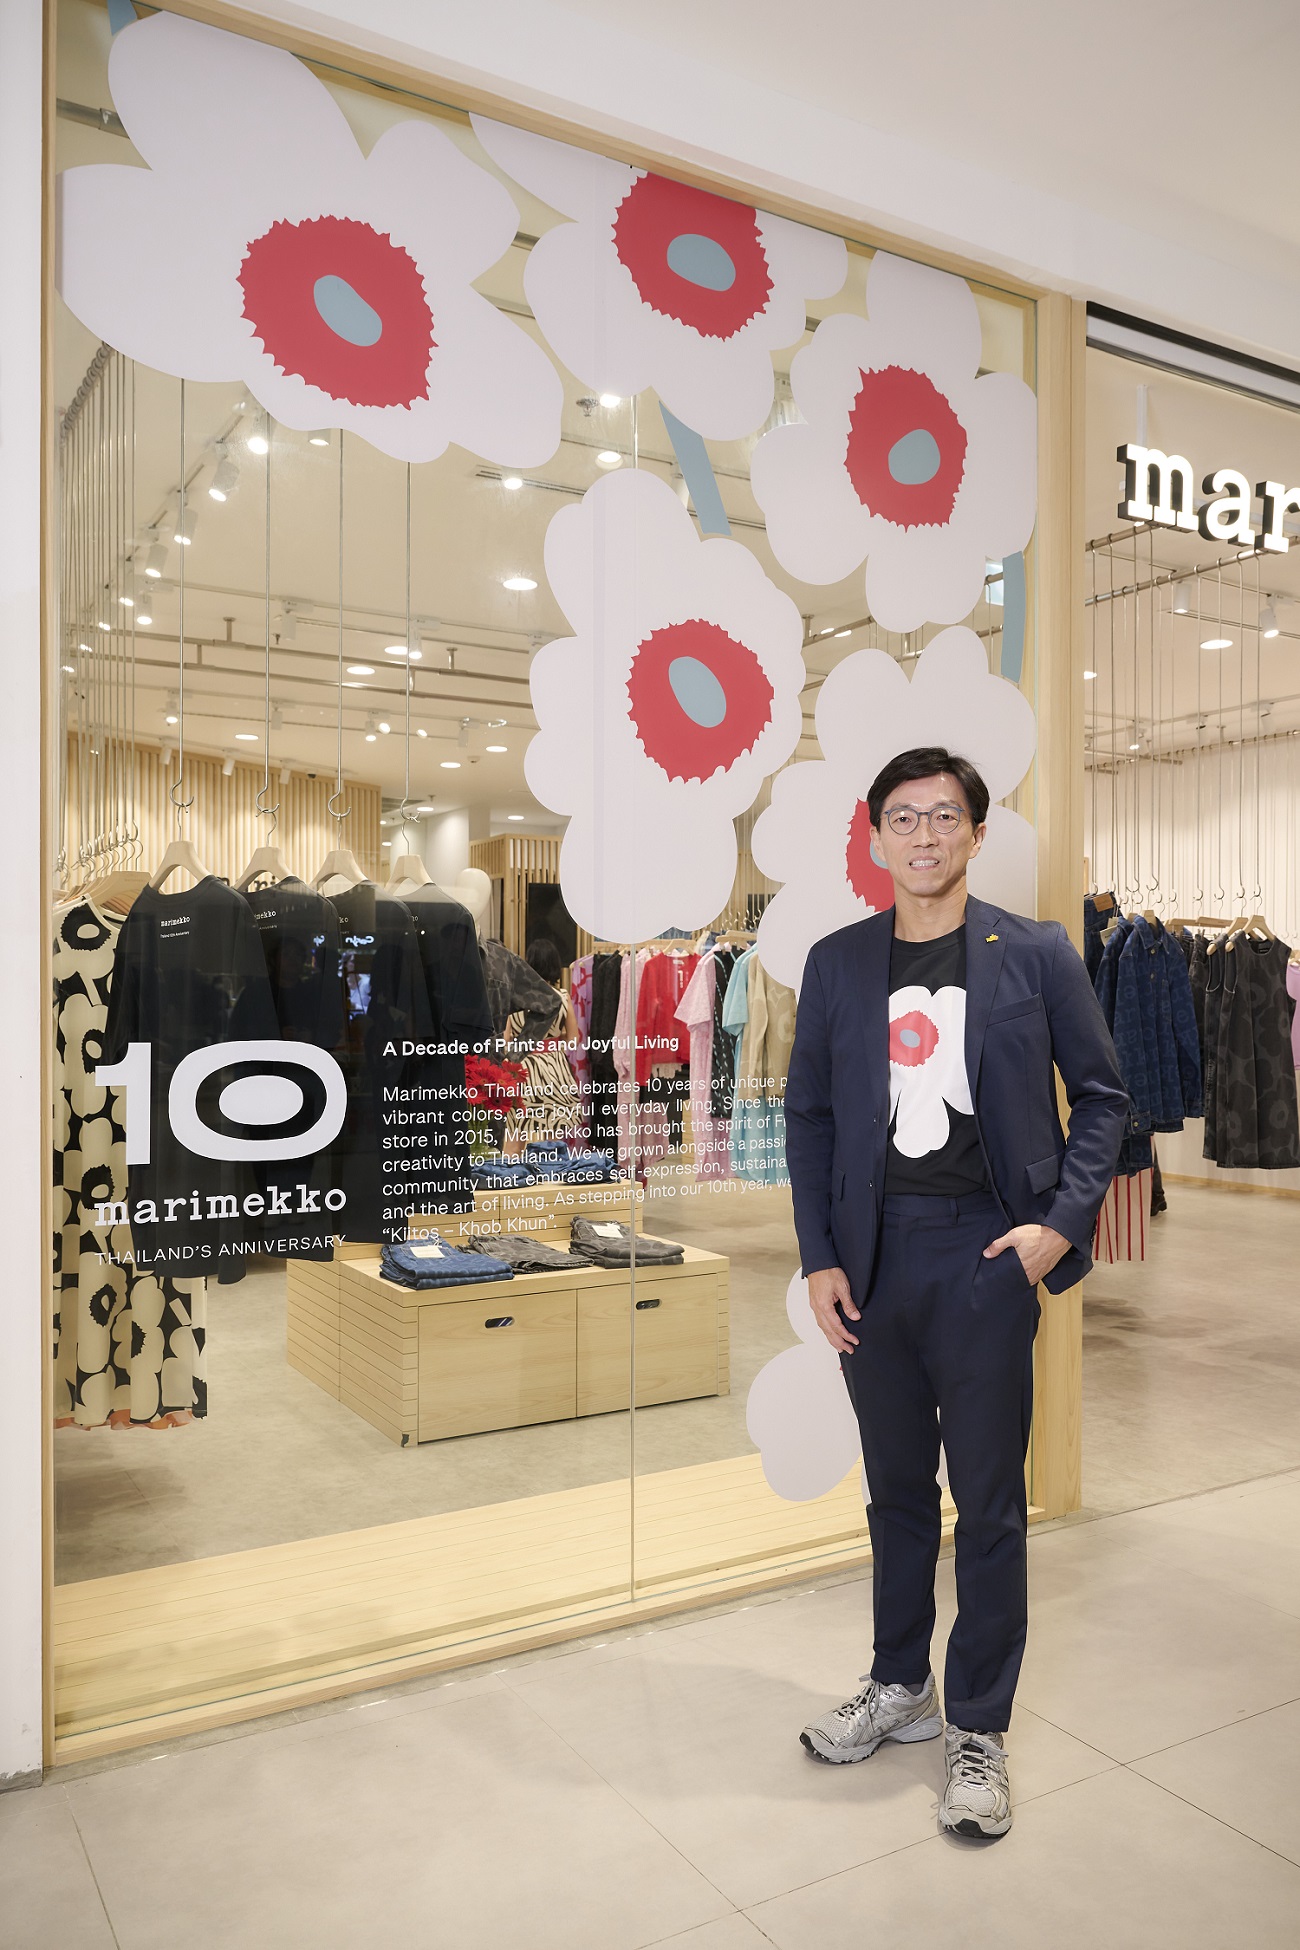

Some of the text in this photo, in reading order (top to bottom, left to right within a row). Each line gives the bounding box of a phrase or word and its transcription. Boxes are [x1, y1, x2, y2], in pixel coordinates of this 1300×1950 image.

[383, 1035, 679, 1057] A Decade of Prints and Joyful Living
[94, 1040, 348, 1166] 10
[383, 1084, 478, 1102] Marimekko
[484, 1082, 554, 1098] Thailand
[560, 1080, 640, 1095] celebrates
[646, 1078, 662, 1092] 10
[668, 1078, 706, 1094] years
[712, 1076, 726, 1090] of
[730, 1074, 774, 1092] unique
[382, 1109, 444, 1125] vibrant
[452, 1106, 508, 1122] colors,
[516, 1105, 545, 1119] and
[552, 1102, 595, 1121] joyful
[602, 1100, 670, 1117] everyday
[676, 1098, 717, 1114] living.
[724, 1096, 760, 1110] Since
[382, 1134, 428, 1149] store
[434, 1132, 448, 1146] in
[454, 1129, 498, 1146] 2015,
[504, 1124, 591, 1142] Marimekko
[596, 1124, 622, 1138] has
[629, 1120, 686, 1136] brought
[691, 1118, 713, 1132] the
[718, 1116, 752, 1133] spirit
[756, 1115, 770, 1129] of
[382, 1134, 786, 1172] creativity to Thailand. We’ve grown alongside a passi
[382, 1156, 787, 1196] community that embraces self-expression, sustaina
[94, 1184, 347, 1227] marimekko
[382, 1202, 415, 1220] and
[420, 1201, 448, 1216] the
[453, 1200, 477, 1214] art
[482, 1196, 499, 1212] of
[504, 1194, 549, 1211] living.
[554, 1192, 574, 1206] As
[579, 1186, 645, 1205] stepping
[650, 1185, 676, 1198] into
[680, 1184, 704, 1196] our
[708, 1179, 736, 1194] 10th
[740, 1179, 772, 1194] year,
[460, 1219, 502, 1236] Khob
[95, 1234, 346, 1266] THAILAND’S ANNIVERSARY
